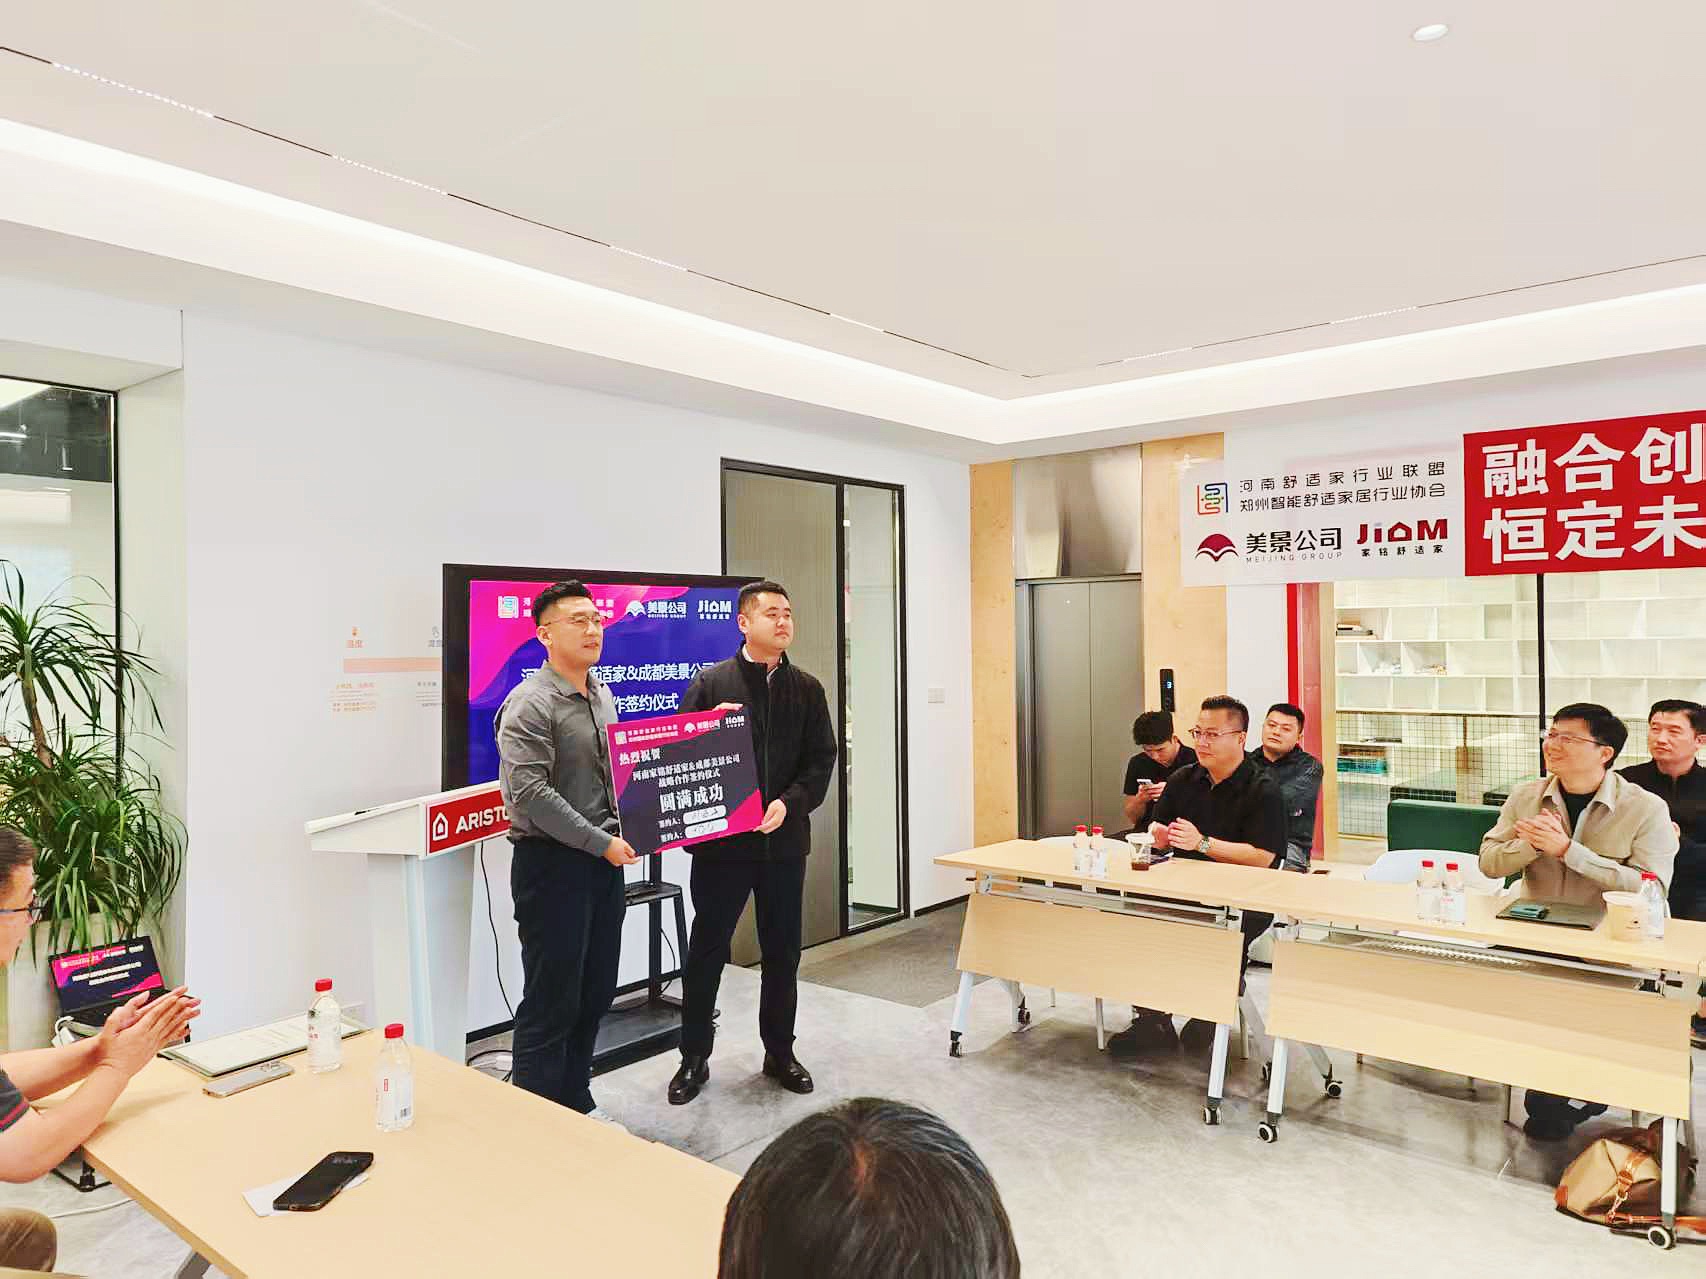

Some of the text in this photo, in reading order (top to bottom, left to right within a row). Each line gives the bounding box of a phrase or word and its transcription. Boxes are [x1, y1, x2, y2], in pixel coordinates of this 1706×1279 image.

[1482, 423, 1706, 498] 融合创
[1240, 461, 1445, 493] 河南舒适家行业联盟
[1240, 483, 1445, 512] 郑州智能舒适家居行业协会
[1246, 528, 1341, 554] 美景公司
[1483, 495, 1706, 564] 恒定未
[1246, 553, 1295, 563] MEIJING
[1361, 544, 1443, 557] 家铭舒适家
[647, 601, 687, 615] 美景公司
